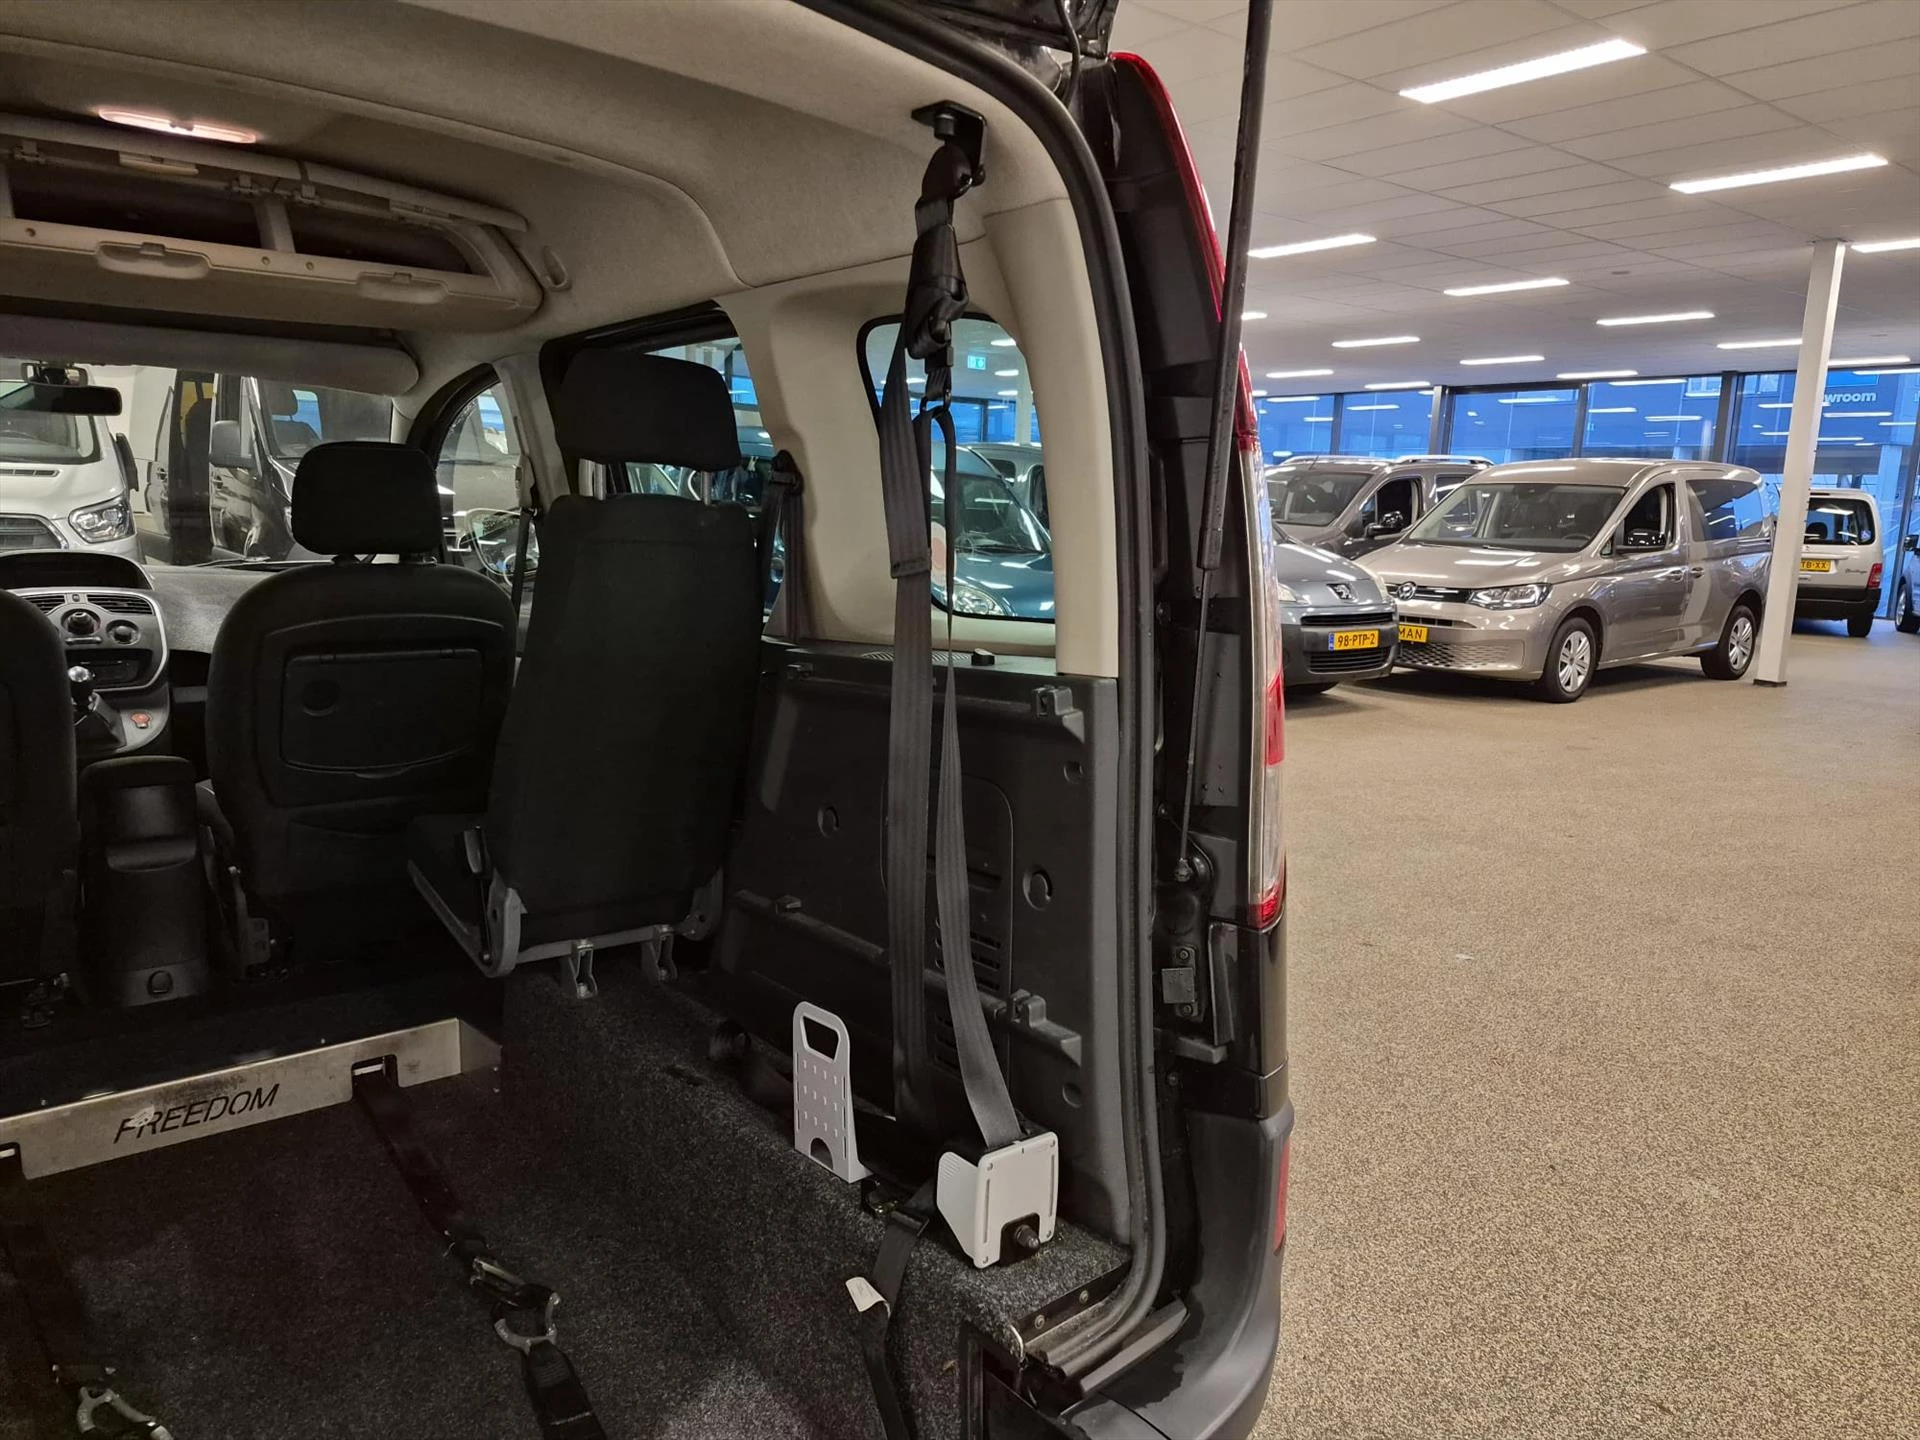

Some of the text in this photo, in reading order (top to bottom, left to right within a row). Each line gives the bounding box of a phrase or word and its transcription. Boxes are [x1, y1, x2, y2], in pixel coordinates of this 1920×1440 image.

[1824, 392, 1877, 403] wroom
[1337, 632, 1376, 647] 98-PTP-2
[113, 1083, 280, 1144] FREEDOM
